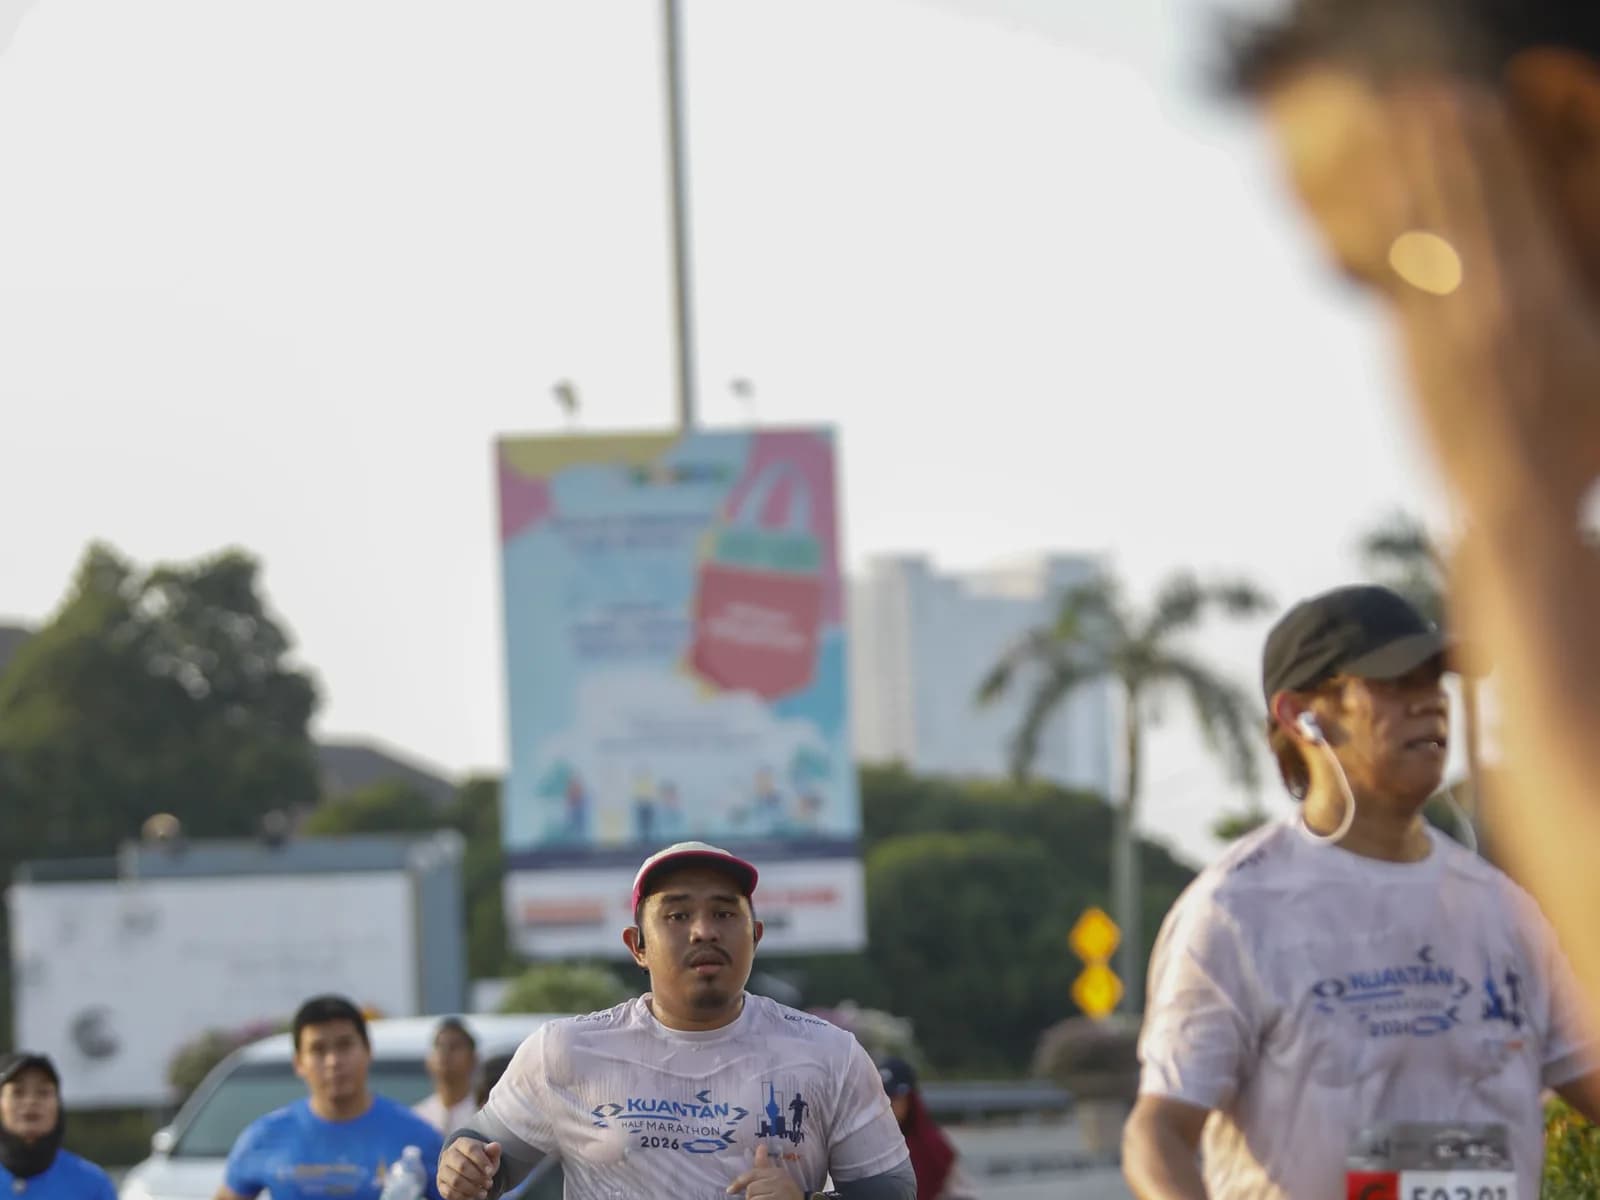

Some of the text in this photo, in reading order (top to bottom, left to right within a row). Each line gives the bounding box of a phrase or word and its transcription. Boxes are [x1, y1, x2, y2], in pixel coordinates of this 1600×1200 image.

[627, 1097, 729, 1119] KUANTAN
[621, 1120, 721, 1136] HALF MARATHON
[641, 1135, 680, 1150] 2026
